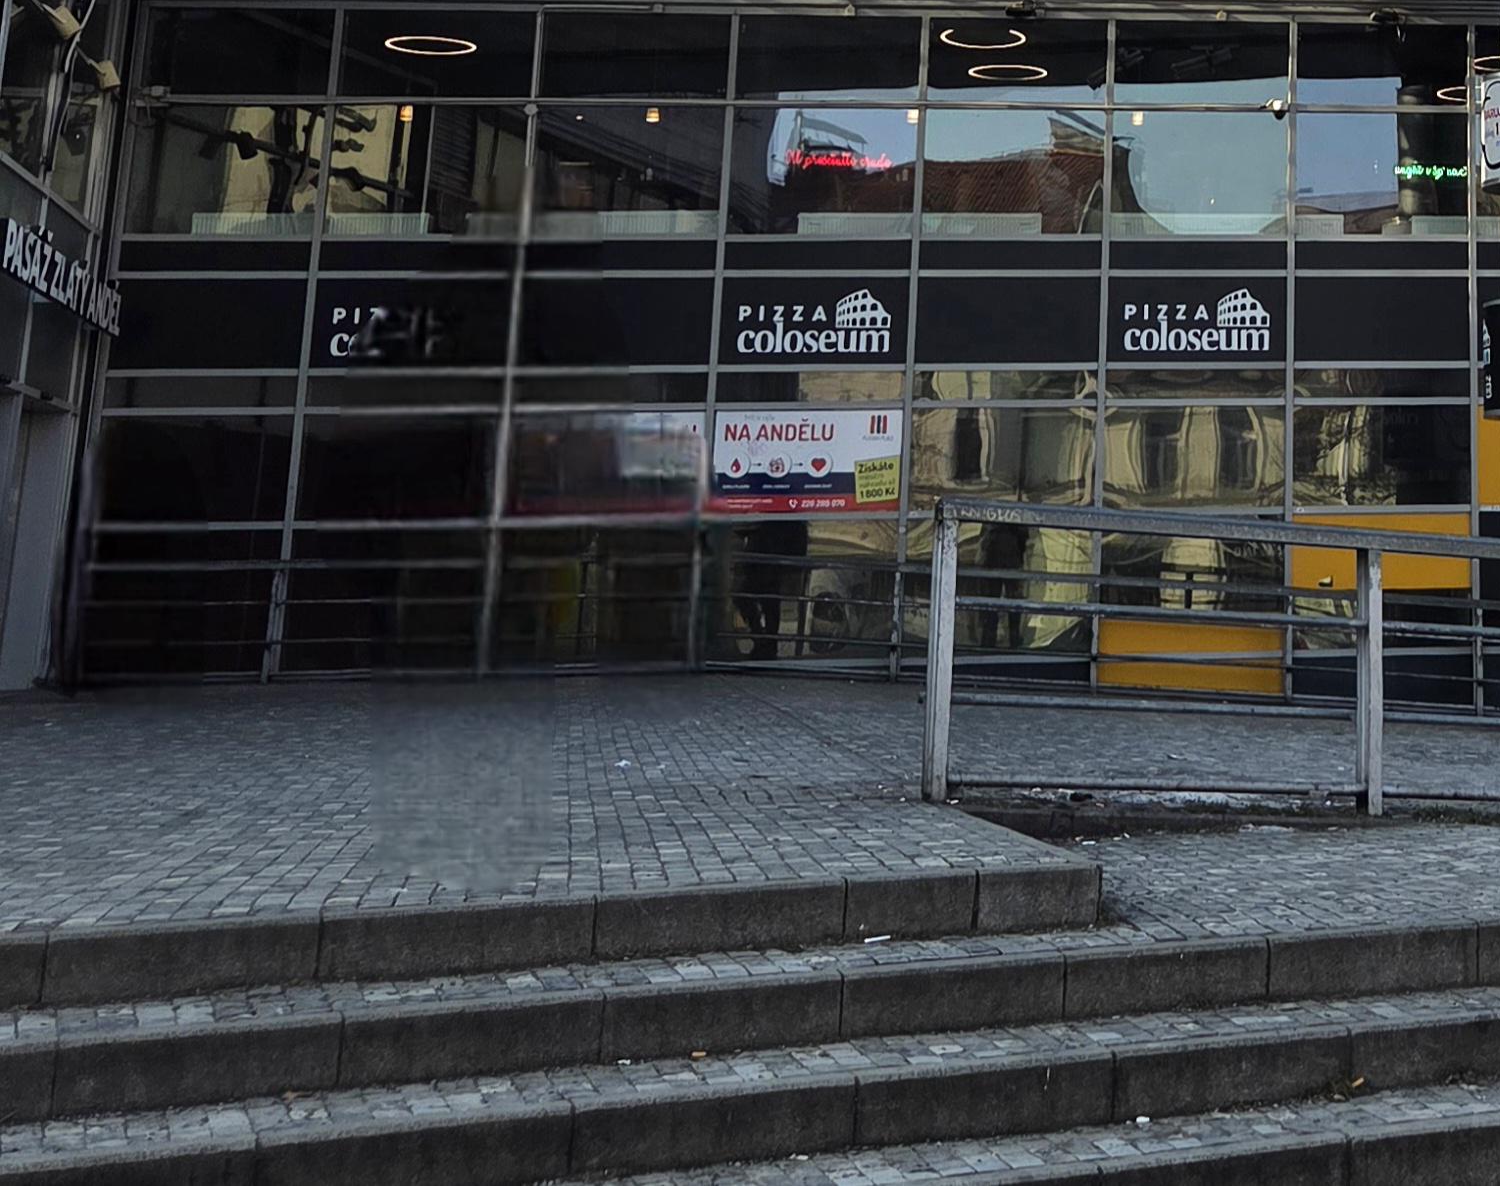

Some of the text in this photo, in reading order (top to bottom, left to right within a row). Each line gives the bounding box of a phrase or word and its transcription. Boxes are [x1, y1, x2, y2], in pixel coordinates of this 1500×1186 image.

[738, 305, 827, 322] PIZZA
[1124, 304, 1209, 320] PIZZA
[737, 320, 890, 353] coloseum
[1123, 318, 1270, 351] coloseum
[724, 418, 834, 441] NA ANDĚLU
[858, 461, 894, 474] Získáte
[884, 487, 896, 496] Kč
